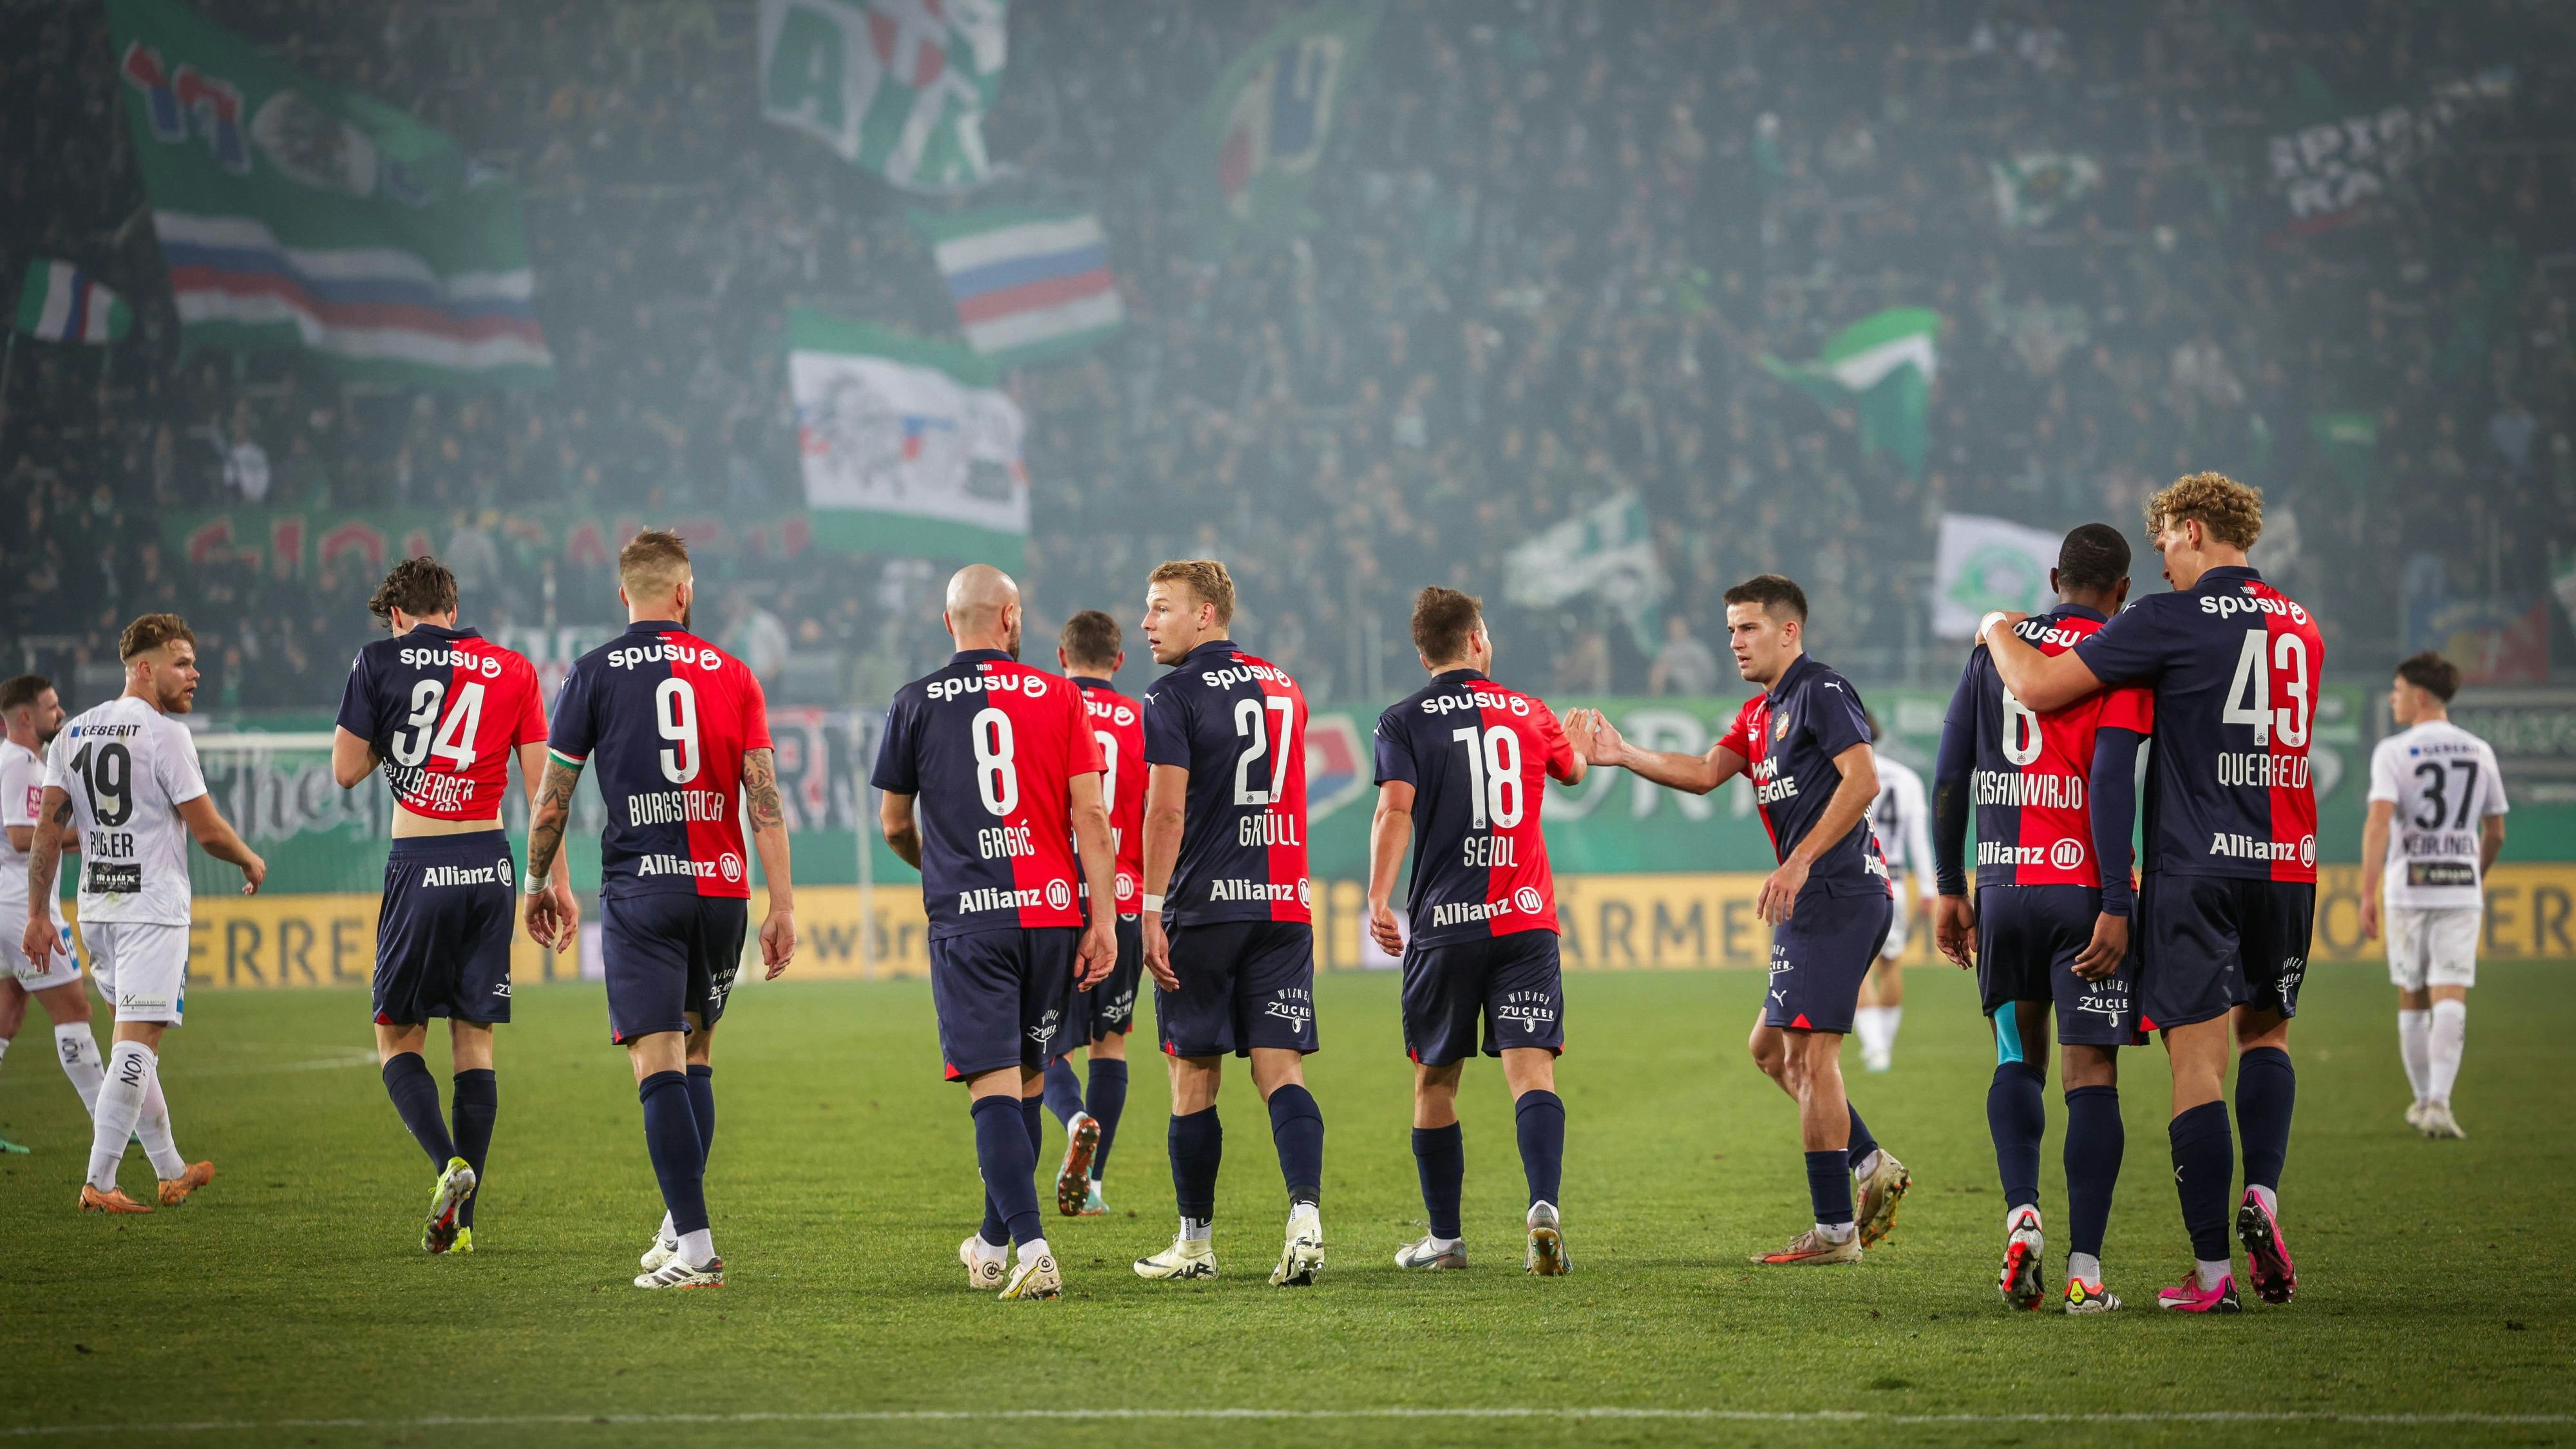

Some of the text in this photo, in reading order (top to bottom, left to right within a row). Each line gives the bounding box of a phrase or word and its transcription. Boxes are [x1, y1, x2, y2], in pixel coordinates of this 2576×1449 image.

[2200, 596, 2287, 619] spusu
[2013, 620, 2081, 647] pusu
[400, 648, 478, 670] spusu
[607, 645, 696, 670] spusu
[927, 674, 1019, 702] spusu
[1202, 665, 1273, 690] spusu
[2222, 629, 2309, 748] 43
[1421, 692, 1506, 715] spusu
[82, 724, 140, 737] GEBERIT
[392, 679, 485, 773] 34
[656, 677, 700, 784] 9
[972, 707, 1019, 817] 8
[1234, 696, 1294, 806] 27
[1453, 725, 1524, 829] 18
[2218, 752, 2309, 789] QUERFELD
[70, 742, 133, 828] 19
[2415, 760, 2478, 831] 37
[978, 819, 1035, 860] GRGIĆ
[1239, 808, 1300, 847] GRÜLL
[1463, 836, 1519, 867] SEIDL
[1977, 841, 2045, 867] Allianz
[2210, 832, 2295, 861] Allianz
[422, 866, 495, 887] Allianz
[638, 854, 716, 878] Allianz
[959, 887, 1042, 914] Allianz
[1209, 878, 1294, 902] Allianz
[1433, 898, 1512, 927] Allianz
[1508, 990, 1550, 1005] WIENER
[1498, 1005, 1555, 1021] ZUCKER
